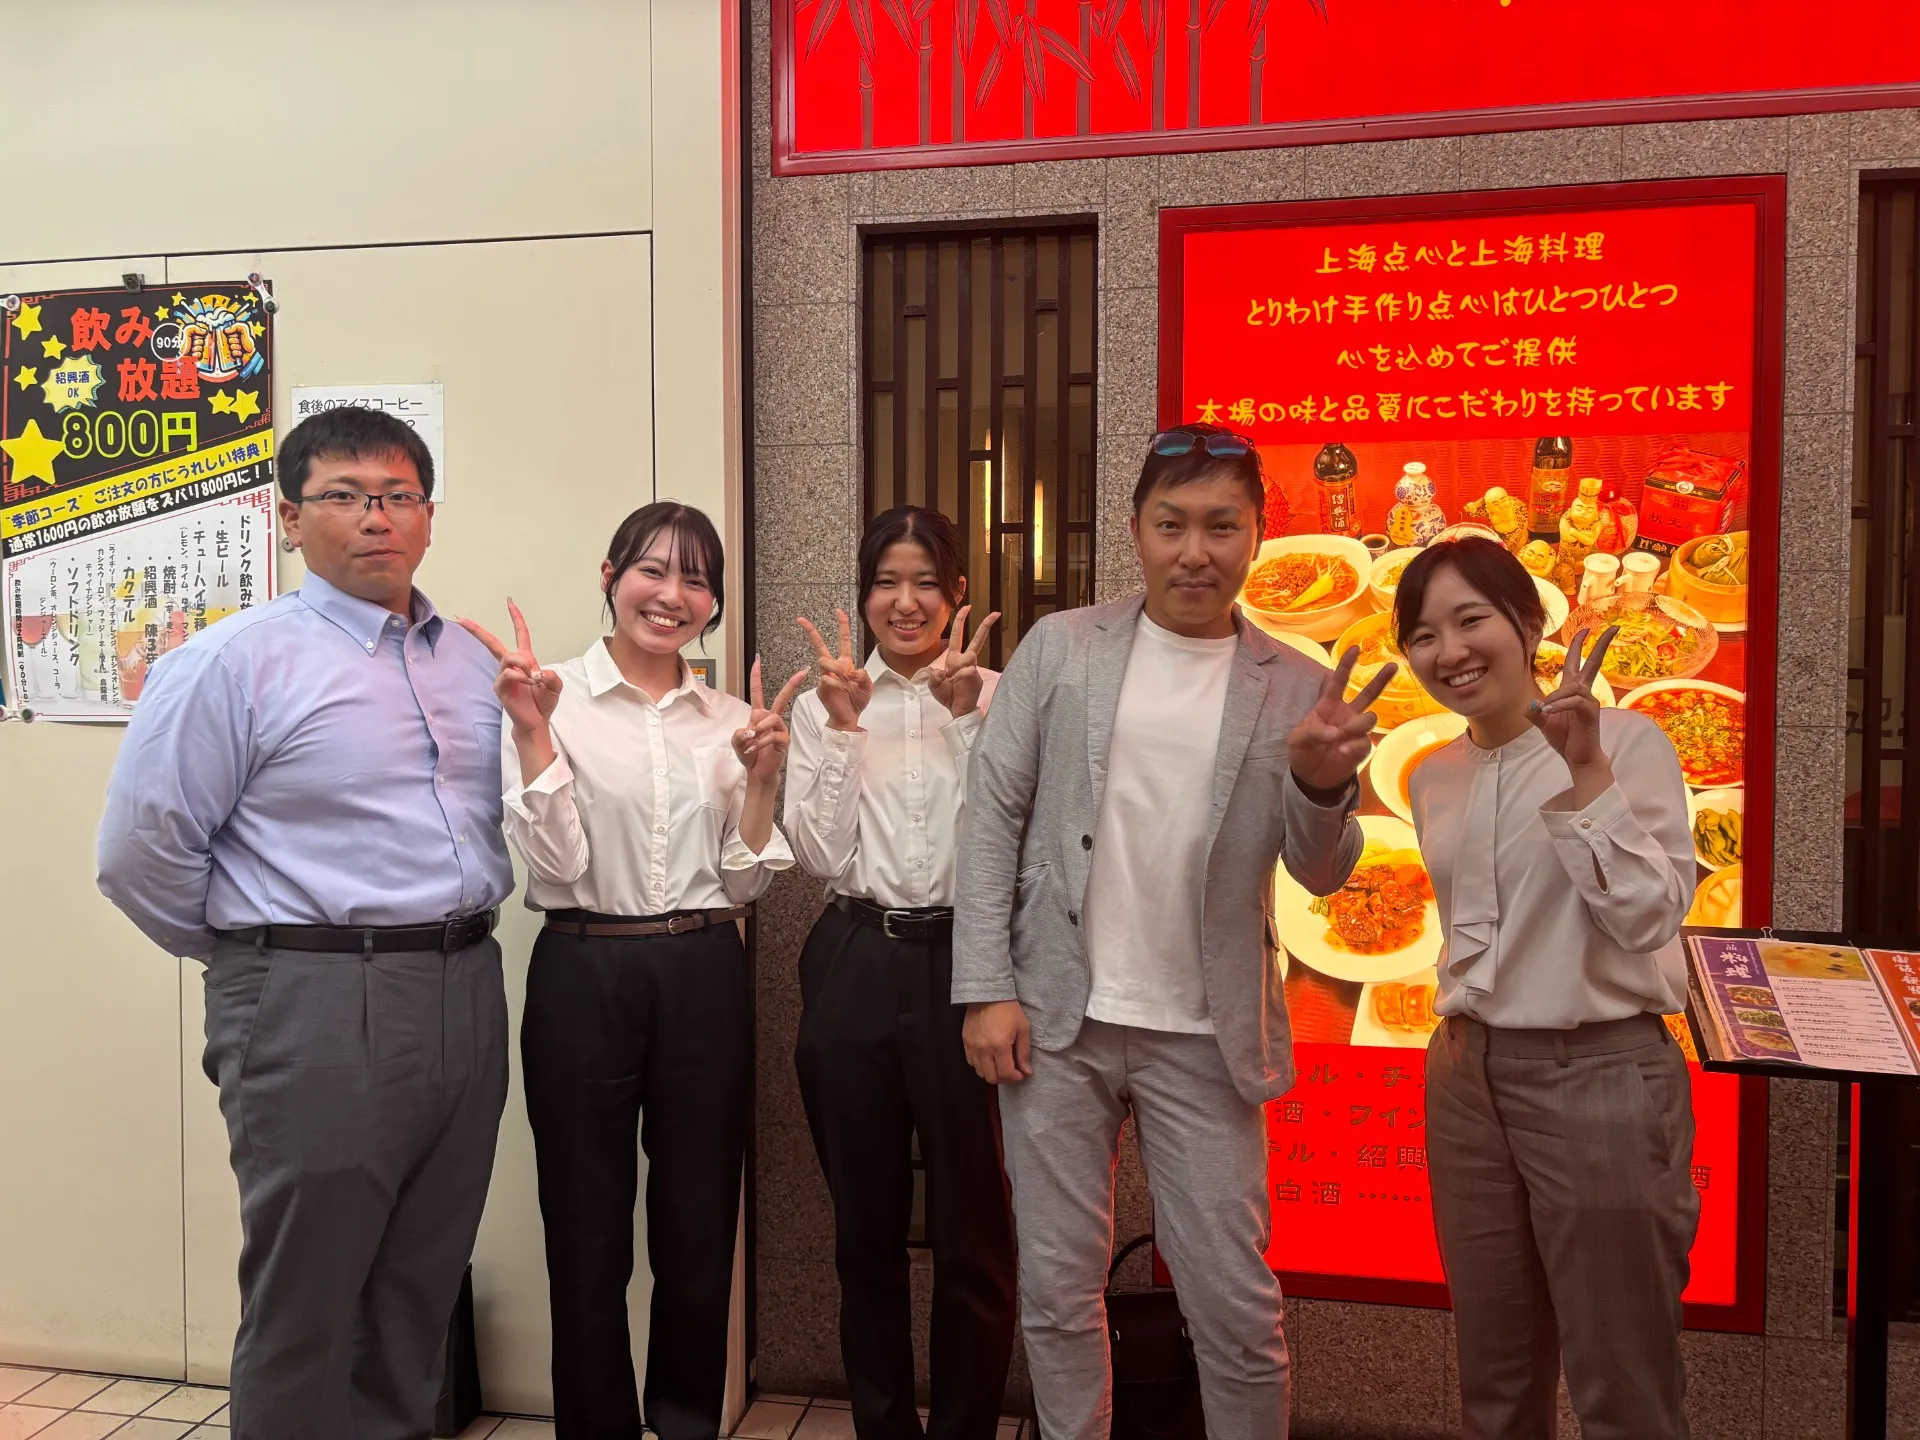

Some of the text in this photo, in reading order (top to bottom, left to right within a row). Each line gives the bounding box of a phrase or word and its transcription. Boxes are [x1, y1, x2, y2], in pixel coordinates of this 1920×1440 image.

[1315, 232, 1605, 273] 上海点心と上海料理
[1247, 281, 1678, 326] とりわけ手作り点心はひとつひとつ
[70, 306, 154, 351] 飲み
[1337, 335, 1577, 372] 心を込めてご提供
[55, 371, 90, 384] 紹興酒
[67, 387, 79, 398] OK
[117, 357, 200, 402] 放題
[1196, 381, 1735, 426] 本場の味と品質にこだわりを持っています
[62, 410, 198, 459] 800円
